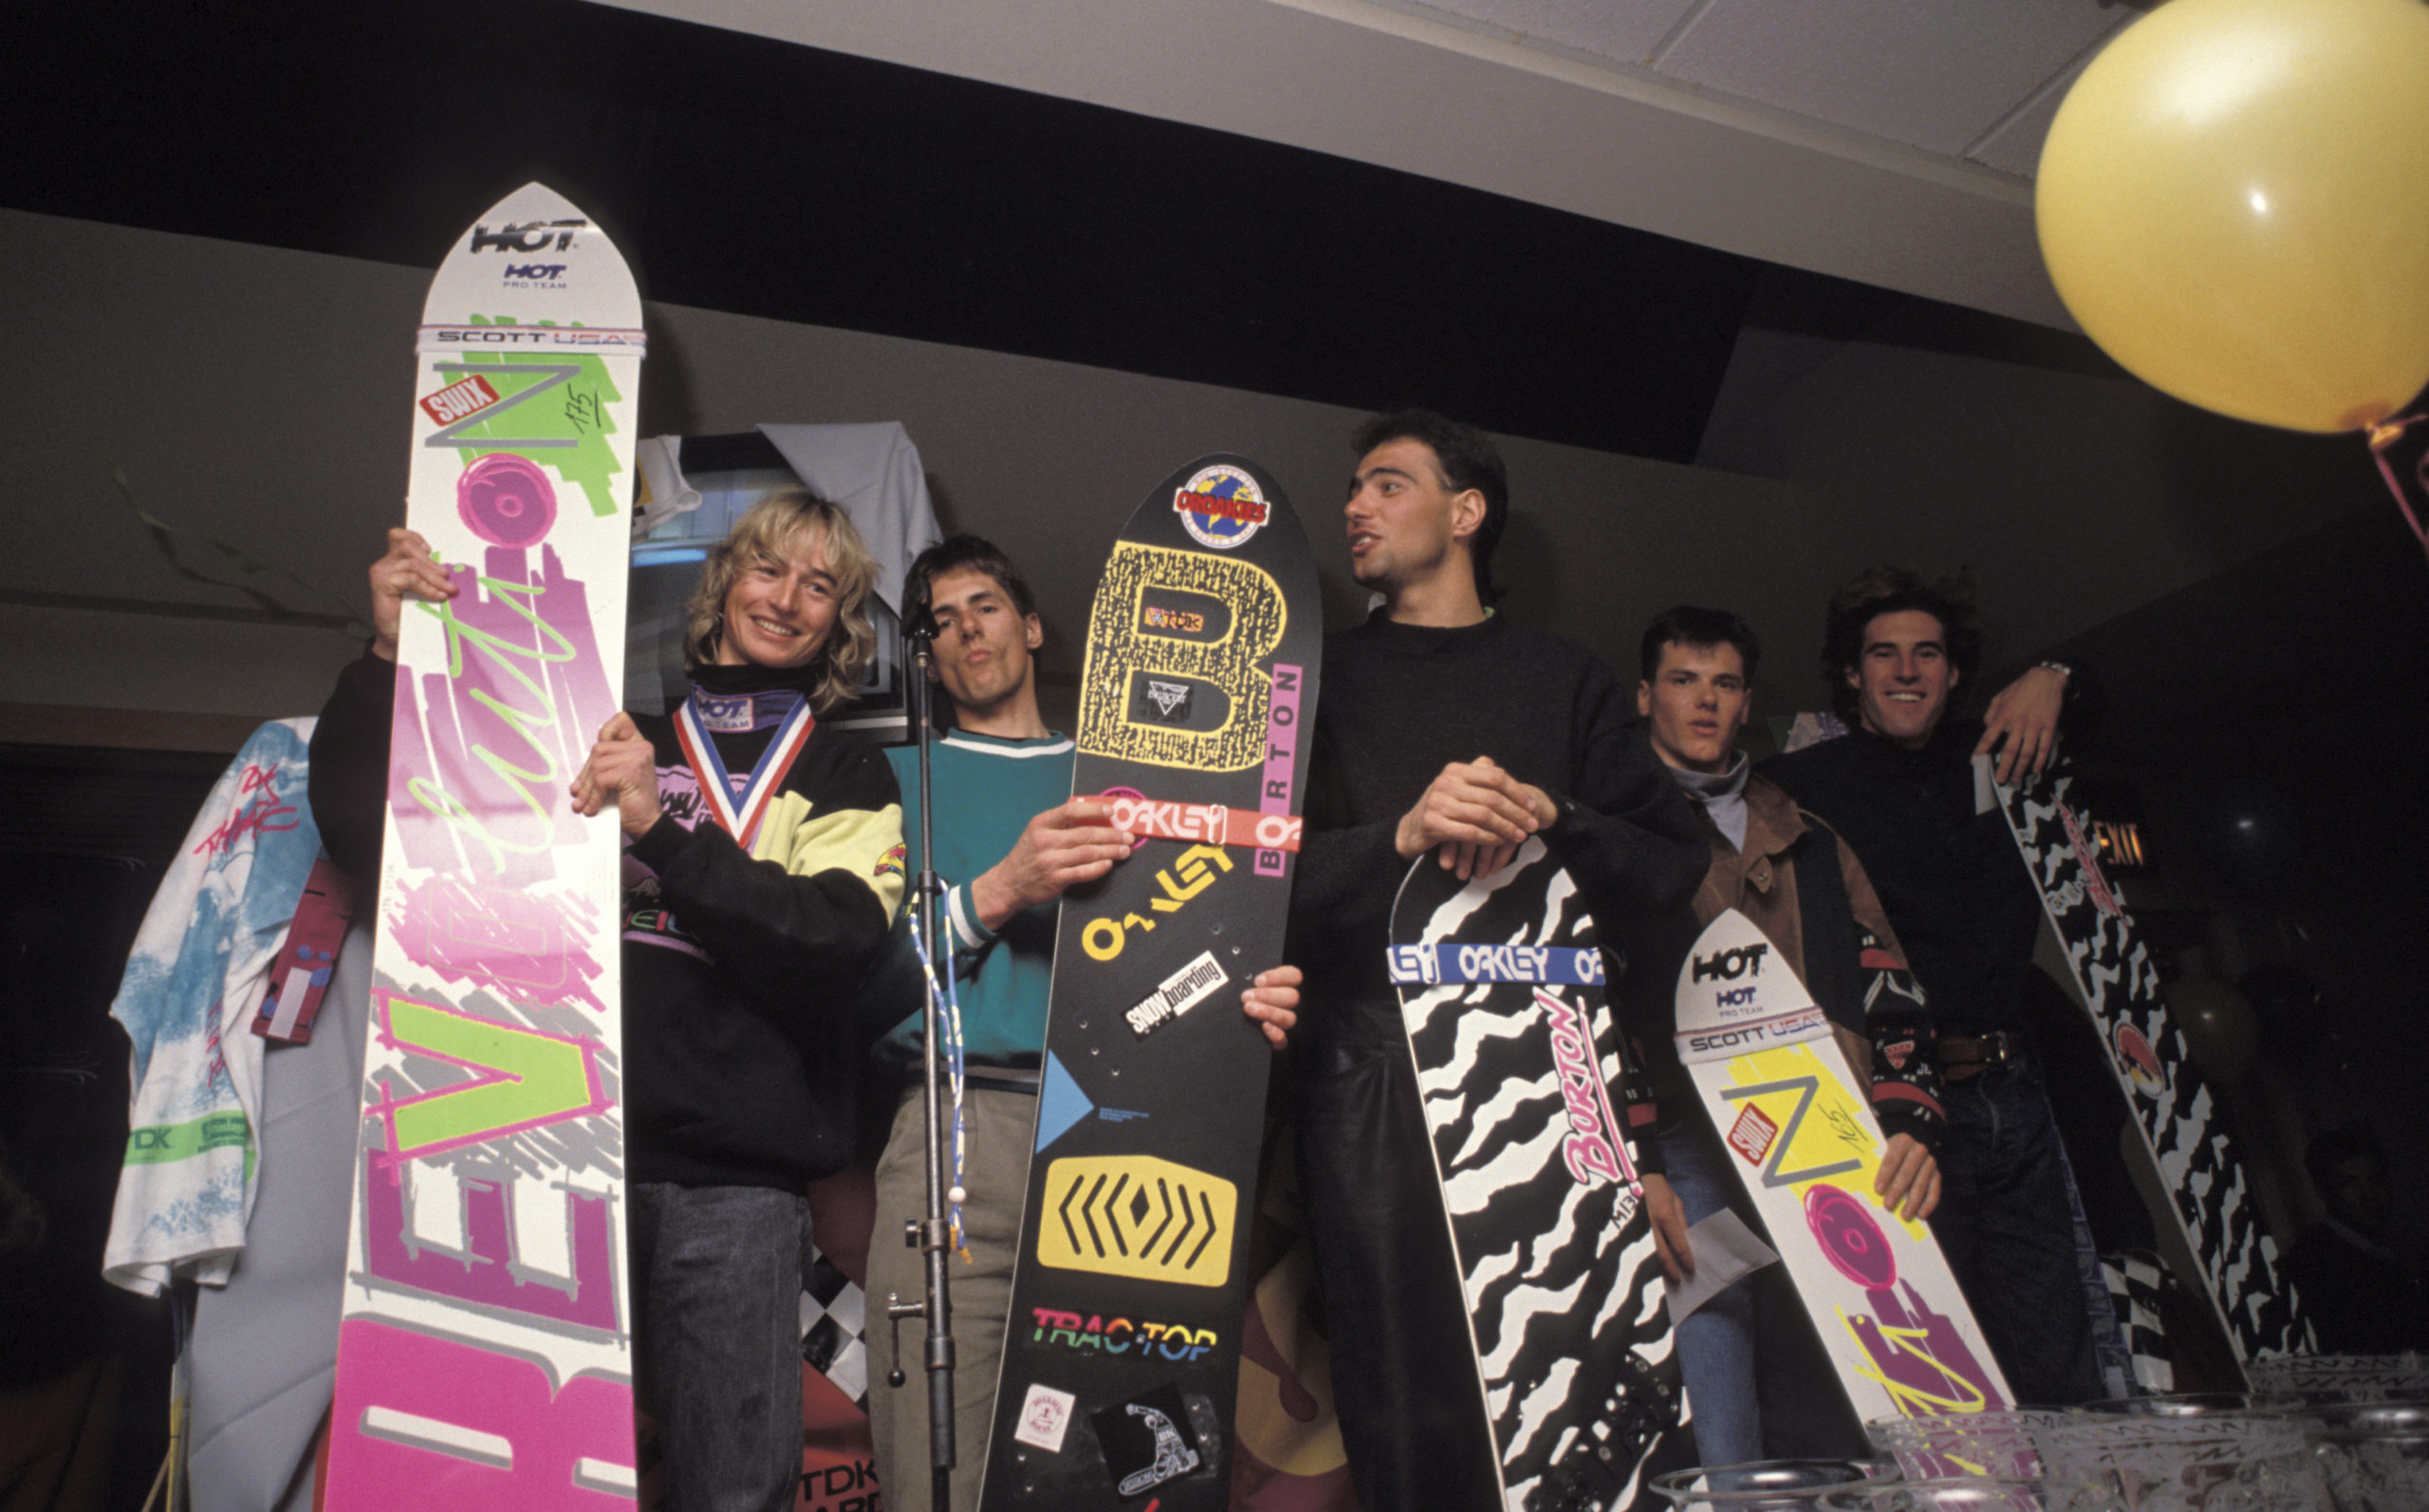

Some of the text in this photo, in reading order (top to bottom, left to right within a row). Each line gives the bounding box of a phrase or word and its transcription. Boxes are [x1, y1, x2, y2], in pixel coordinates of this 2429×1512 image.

[471, 219, 586, 254] HOT
[504, 264, 566, 279] HOT
[437, 331, 546, 343] SCOTT
[428, 377, 494, 424] SWIX
[1176, 489, 1268, 524] CROAKIES
[1258, 671, 1298, 869] BRTON
[1109, 799, 1223, 840] OAKLEY
[2093, 821, 2143, 865] EXIT
[1458, 945, 1548, 982] OAKLEY
[1692, 943, 1768, 985] HOT
[1716, 986, 1756, 1007] HOT
[1719, 1005, 1764, 1018] PRO TEAM
[1690, 1027, 1765, 1052] SCOTT
[1533, 986, 1620, 1185] BURTON
[1730, 1107, 1775, 1163] SWIX
[801, 1458, 880, 1503] TDK
